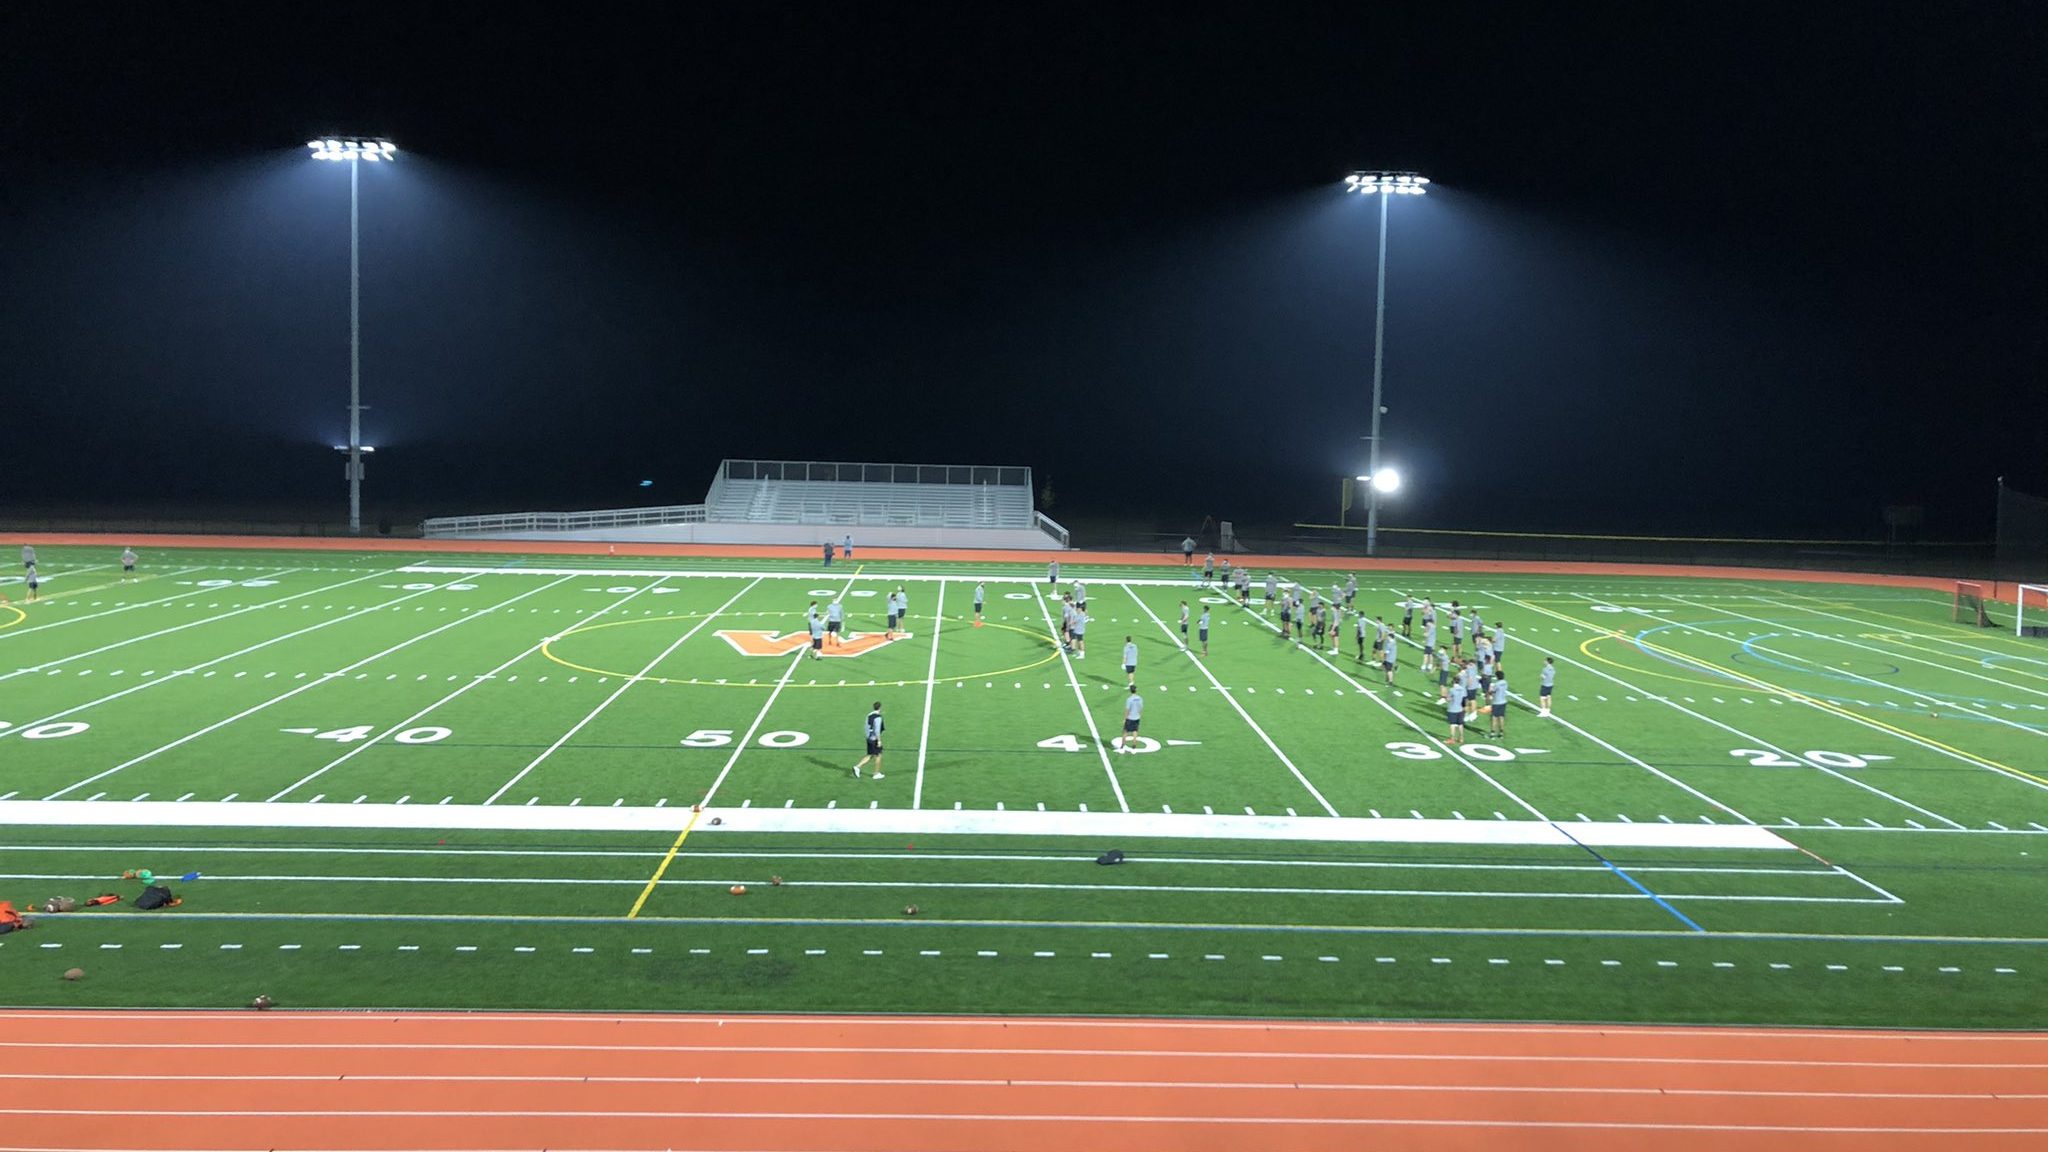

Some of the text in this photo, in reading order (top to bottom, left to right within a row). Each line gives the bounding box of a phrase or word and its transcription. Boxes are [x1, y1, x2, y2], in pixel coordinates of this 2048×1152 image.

[712, 630, 913, 657] W
[314, 725, 453, 743] 40
[680, 729, 811, 748] 50
[1037, 734, 1162, 754] 40
[1385, 742, 1516, 761] 30
[1729, 749, 1868, 768] 20
